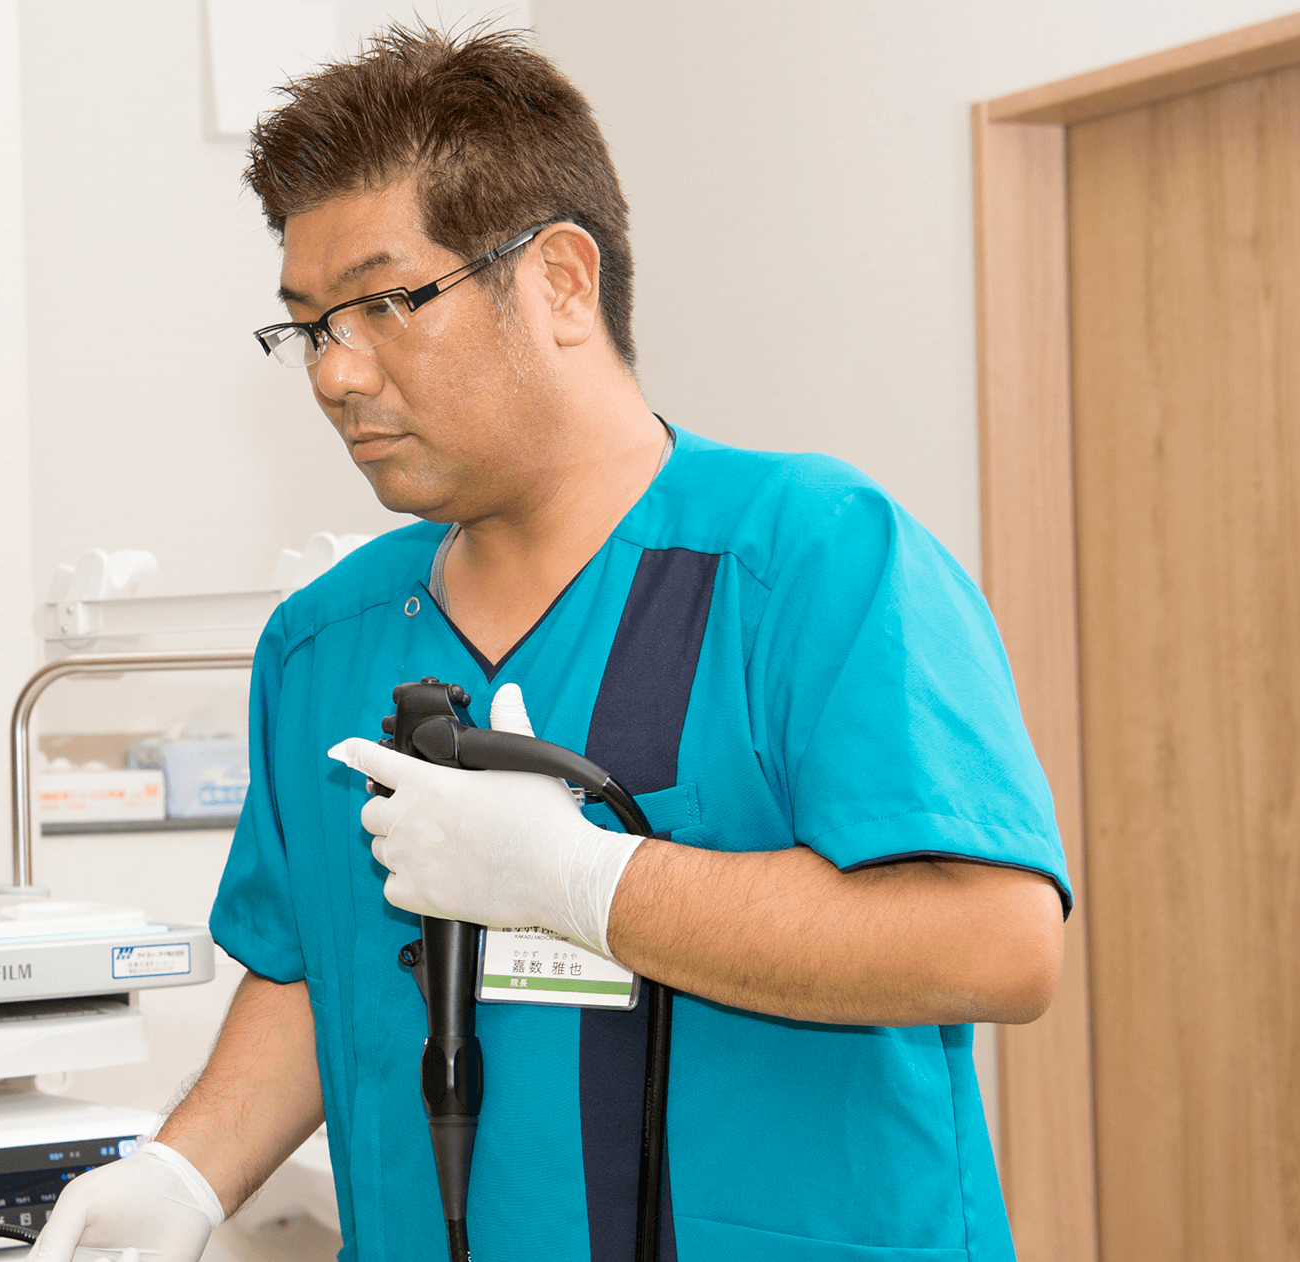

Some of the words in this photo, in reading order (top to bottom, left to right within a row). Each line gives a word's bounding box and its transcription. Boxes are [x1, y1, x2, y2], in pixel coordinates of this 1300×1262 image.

[512, 960, 542, 974] 嘉数
[552, 962, 582, 977] 雅也
[510, 979, 528, 988] 院長
